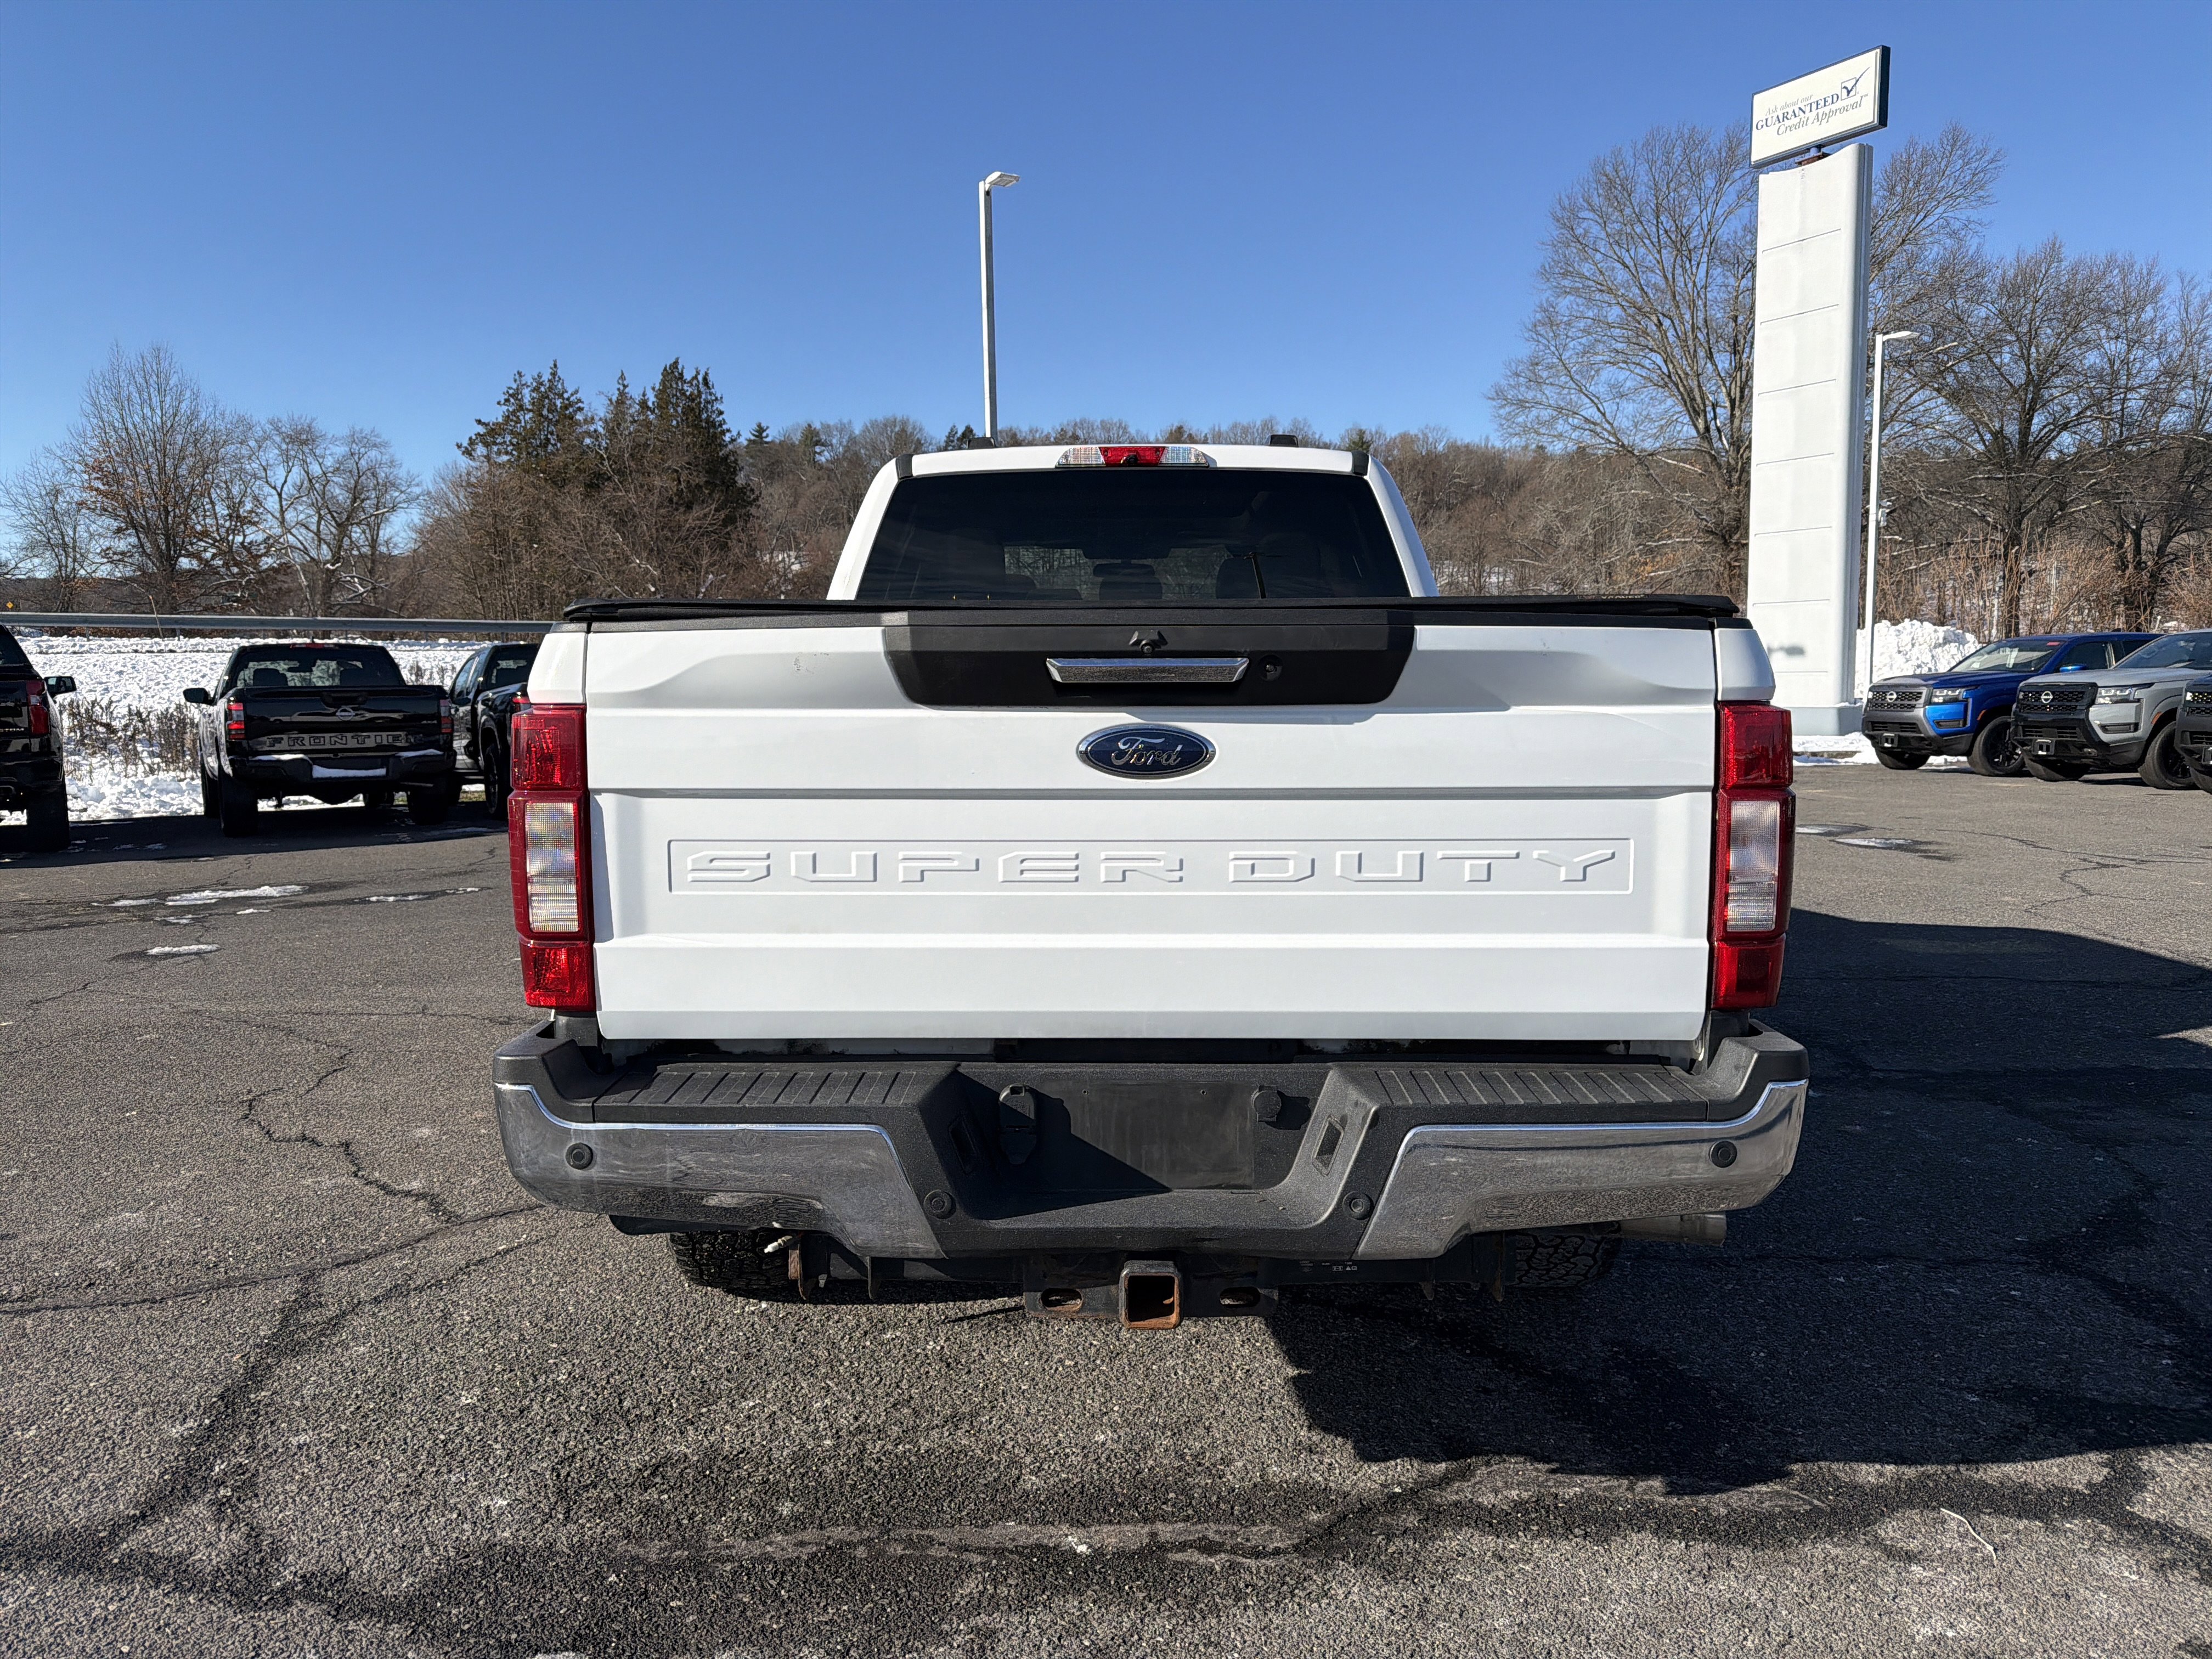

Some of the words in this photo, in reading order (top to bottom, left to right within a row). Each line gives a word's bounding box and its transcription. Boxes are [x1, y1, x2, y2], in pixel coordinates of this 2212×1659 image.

[1756, 93, 1839, 131] GUARANTEED
[1765, 106, 1778, 116] Ask
[1780, 99, 1799, 111] about
[1801, 94, 1813, 104] our
[1776, 116, 1810, 136] Credit
[1811, 95, 1864, 126] Approval
[1110, 736, 1184, 765] Ford
[687, 850, 1183, 883] SUPER
[1228, 849, 1616, 882] DUTY
